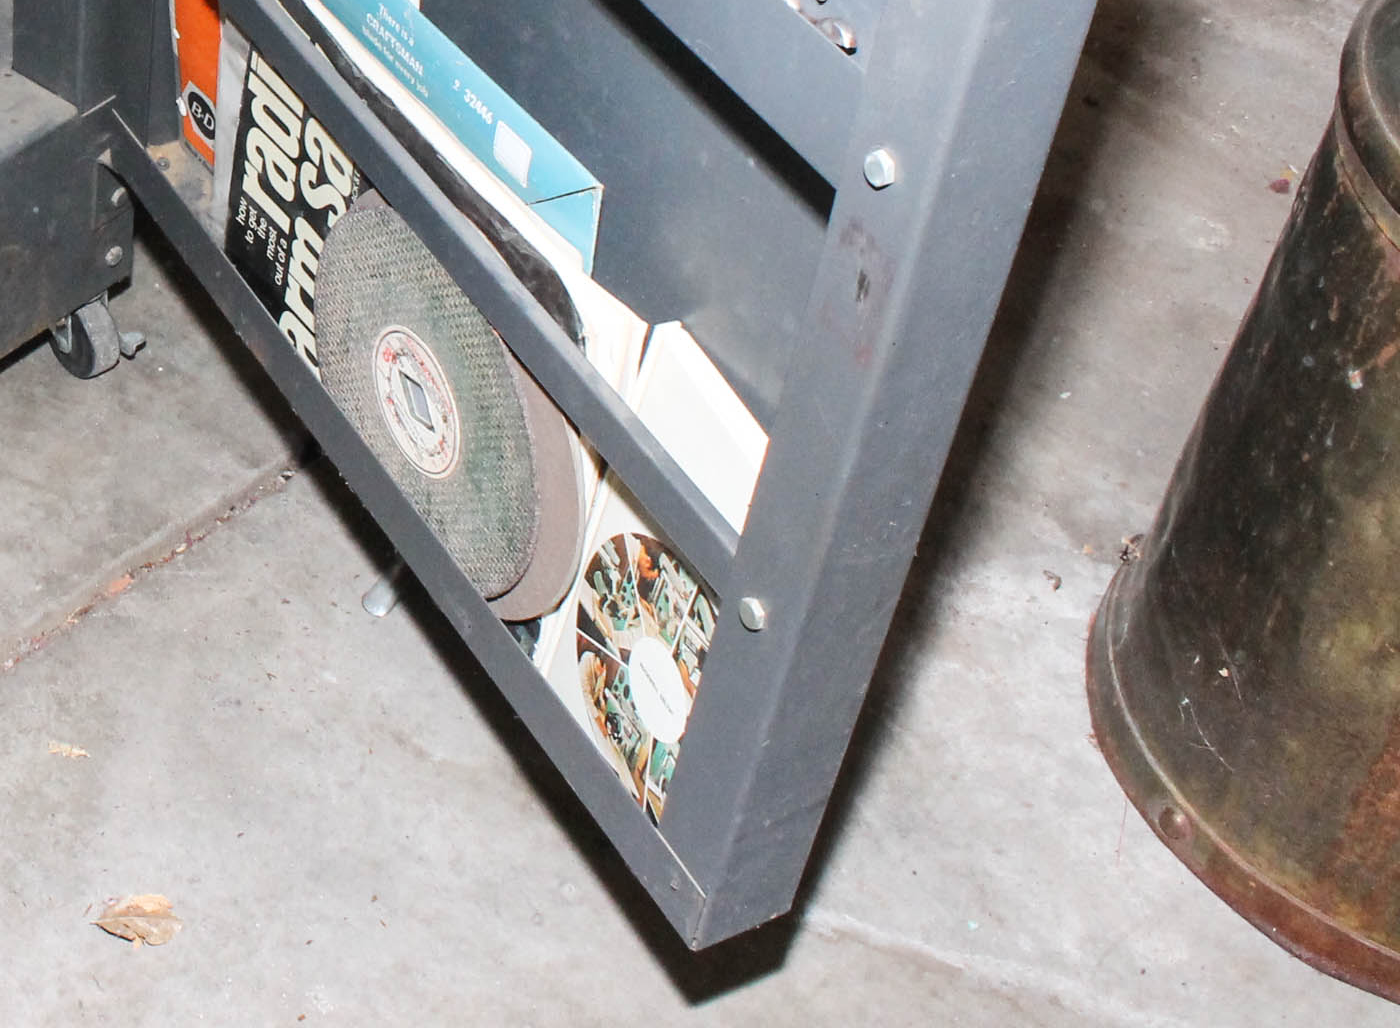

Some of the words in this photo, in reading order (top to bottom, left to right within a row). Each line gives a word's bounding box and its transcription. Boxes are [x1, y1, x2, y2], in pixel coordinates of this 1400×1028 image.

[367, 13, 423, 76] CRAFTSMAN
[235, 196, 247, 226] how
[248, 206, 258, 230] get
[245, 230, 254, 244] to
[257, 217, 267, 240] the
[266, 226, 277, 261] most
[277, 244, 286, 263] of
[280, 238, 287, 249] a
[275, 261, 285, 286] out
